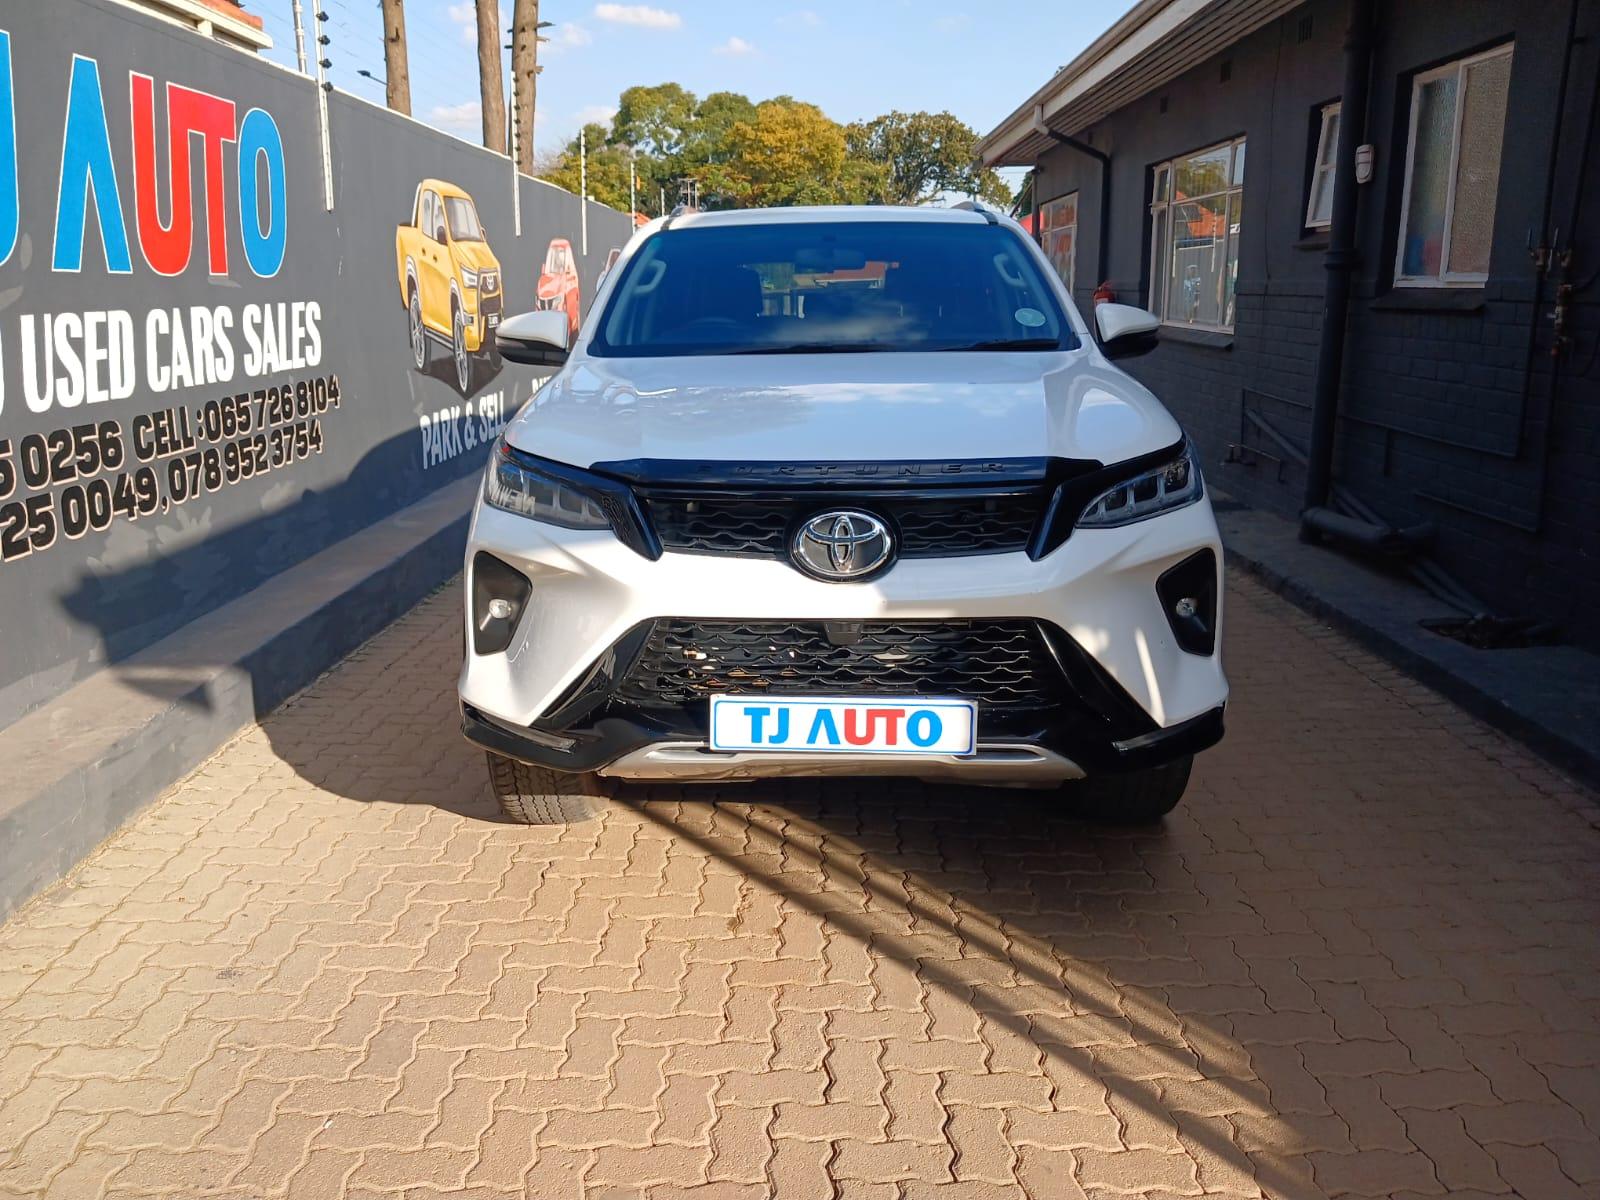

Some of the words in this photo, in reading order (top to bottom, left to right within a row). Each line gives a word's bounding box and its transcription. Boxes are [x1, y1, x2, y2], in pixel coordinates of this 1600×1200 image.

[51, 53, 287, 278] AUTO
[20, 309, 136, 413] USED
[146, 305, 234, 392] CARS
[242, 301, 322, 377] SALES
[20, 420, 124, 491] 0256
[419, 405, 463, 470] PARK
[464, 401, 477, 451] &
[743, 707, 790, 744] TJ
[806, 708, 943, 748] AUTO
